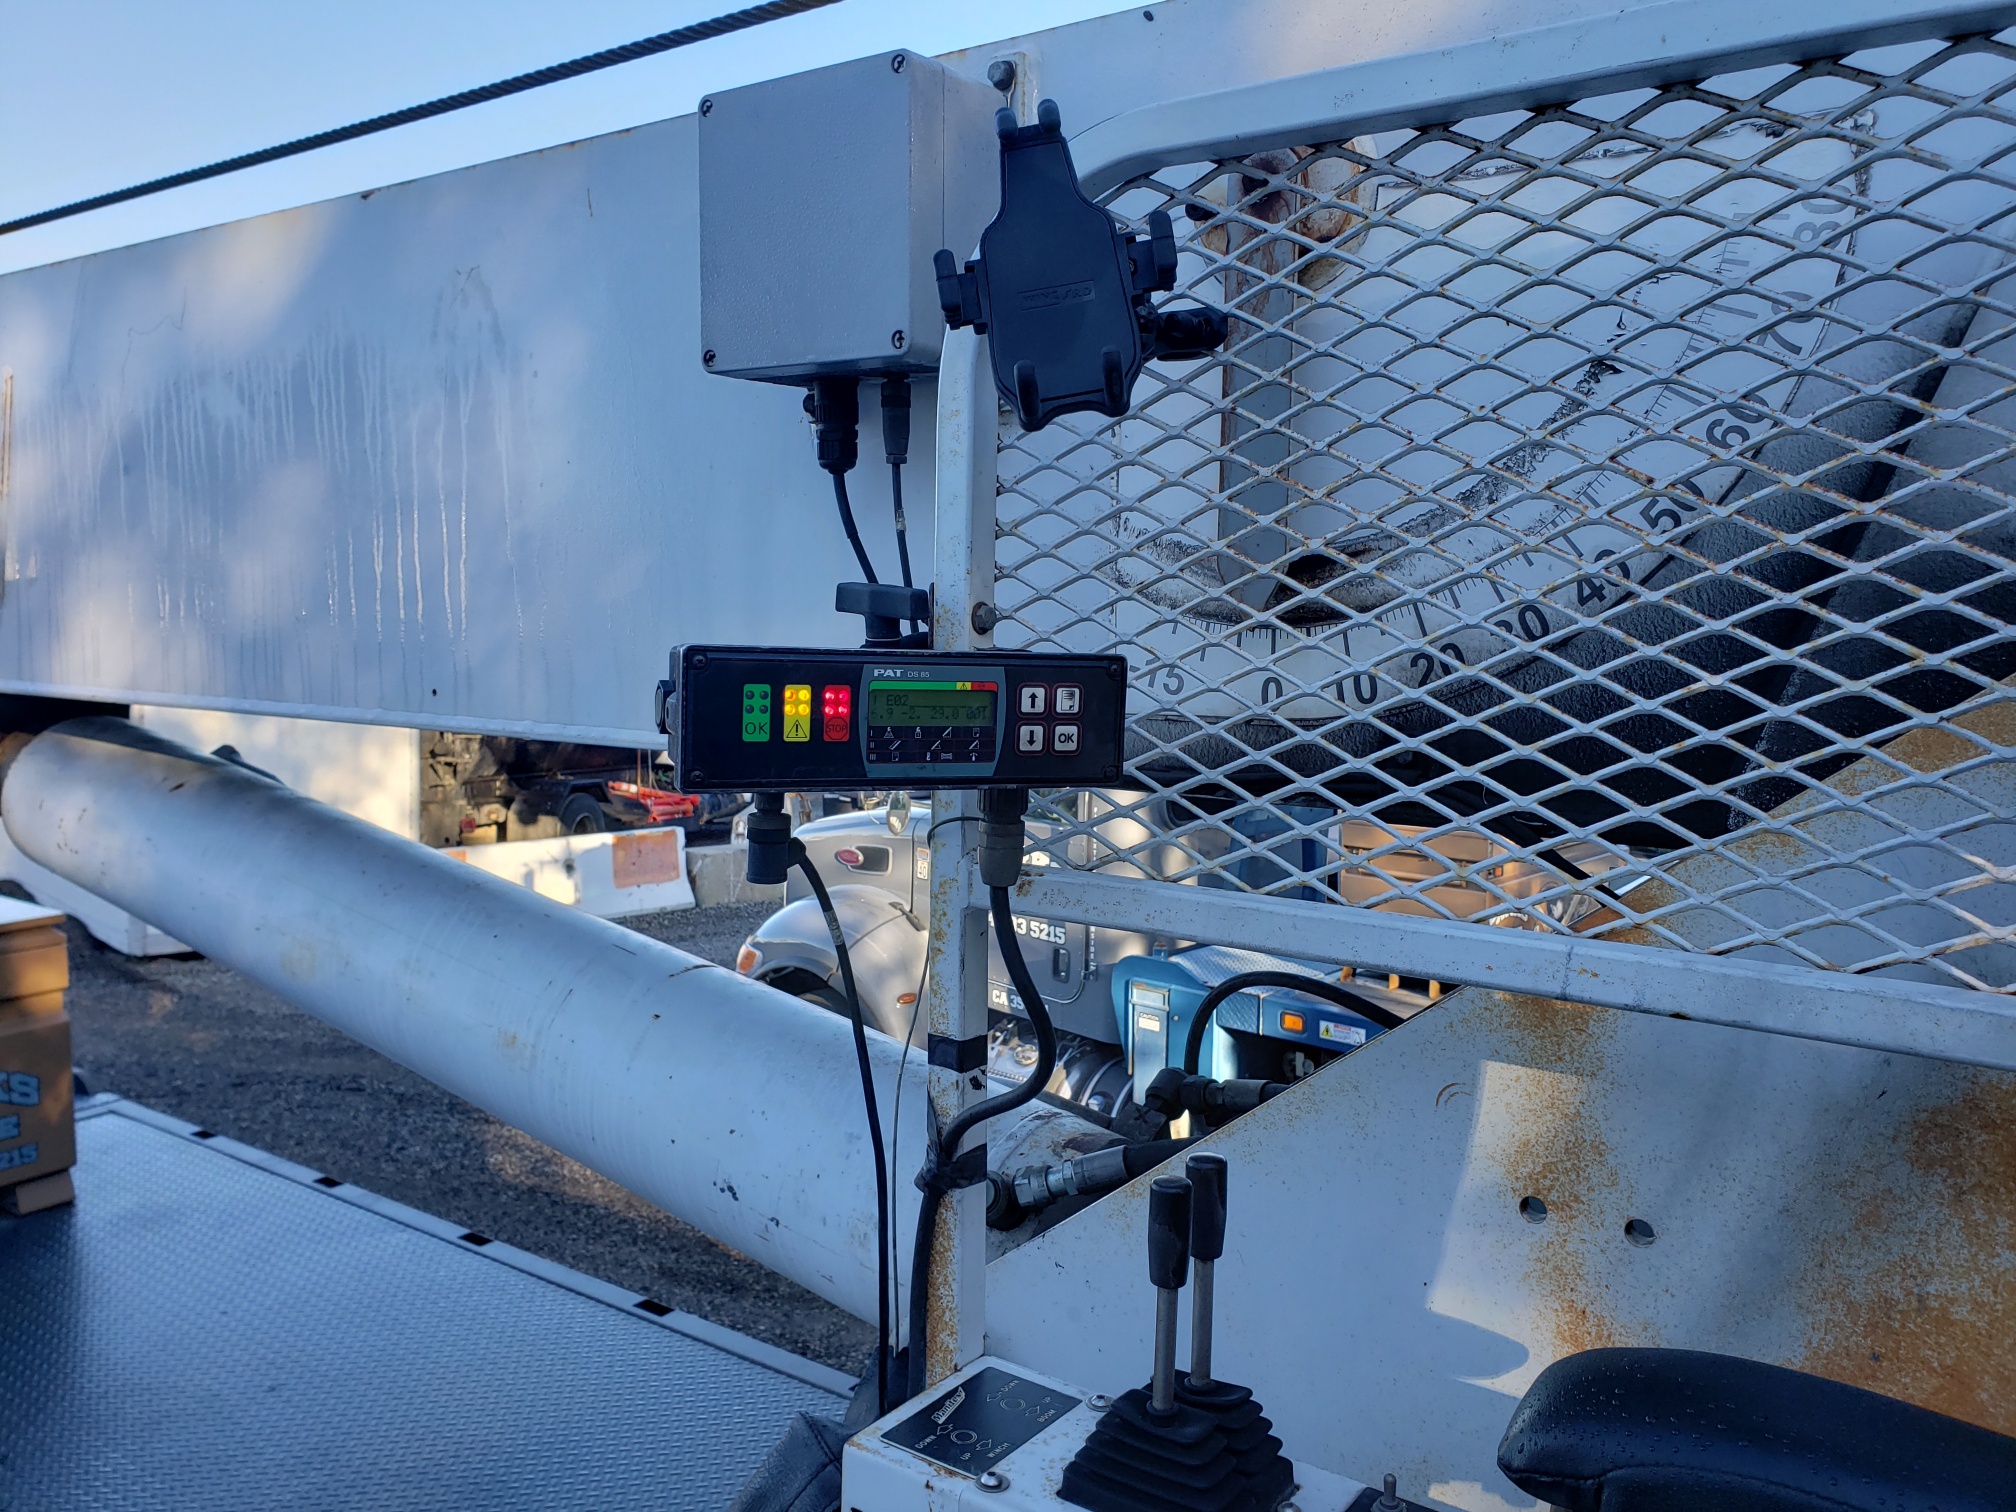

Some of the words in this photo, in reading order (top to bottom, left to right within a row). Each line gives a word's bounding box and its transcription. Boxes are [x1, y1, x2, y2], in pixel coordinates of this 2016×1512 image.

[873, 668, 904, 677] PAT
[745, 721, 768, 735] OK
[826, 723, 848, 733] STOP
[1058, 733, 1075, 744] OK
[1030, 920, 1066, 945] 5215
[992, 989, 1009, 1006] CA
[932, 1387, 966, 1423] Manitex
[1037, 1409, 1057, 1423] BOOM
[915, 1434, 937, 1449] DOWN
[960, 1452, 972, 1461] UP
[986, 1442, 1010, 1458] WINCH
